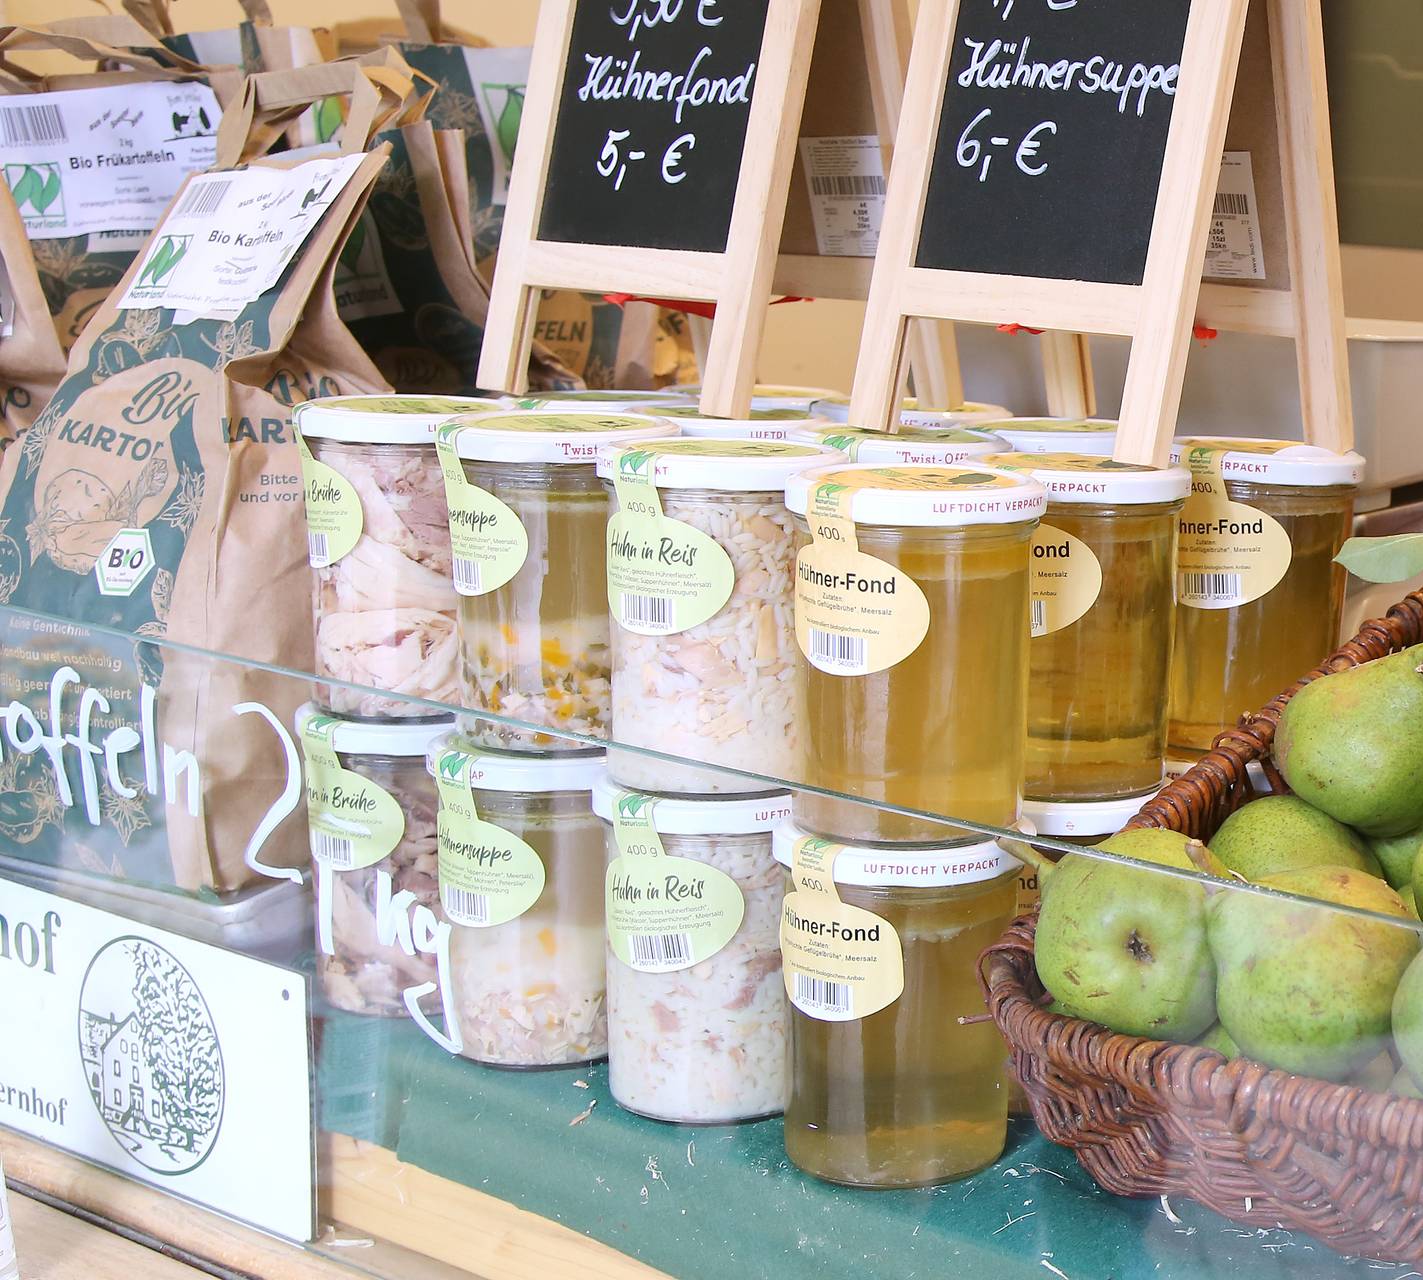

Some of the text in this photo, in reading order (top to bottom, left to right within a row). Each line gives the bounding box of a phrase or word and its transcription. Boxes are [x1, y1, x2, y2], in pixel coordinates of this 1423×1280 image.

[578, 46, 755, 124] Hühnerfond
[958, 36, 1181, 117] Hühnersuppe
[956, 108, 1009, 182] 6,-
[1015, 121, 1057, 176] €
[69, 157, 93, 170] Bio
[97, 150, 175, 168] Frükartoffeln
[597, 129, 696, 191] 5,- €
[207, 230, 230, 244] Bio
[260, 474, 298, 486] Bitte
[1191, 482, 1212, 494] 400
[240, 492, 269, 504] und
[311, 478, 342, 505] Brühe
[627, 500, 656, 517] 400 g
[932, 496, 1043, 513] LUFTDICHT VERPACKT
[817, 525, 840, 541] 400
[610, 528, 698, 567] Huhn in Reis
[1233, 546, 1261, 554] Meersalz
[798, 560, 896, 595] Hühner-Fond
[1038, 571, 1068, 579] Meersalz
[860, 606, 893, 617] Meersalz
[0, 666, 200, 827] offeln
[321, 788, 329, 804] in
[332, 786, 377, 812] Brühe
[449, 802, 472, 820] 400 g
[619, 819, 649, 828] Naturland
[627, 844, 658, 858] 400 g
[864, 857, 1001, 875] LUFTDICHT VERPACKT
[612, 873, 705, 904] Huhn in Reis
[801, 876, 823, 892] 400
[784, 904, 880, 942] Hühner-Fond
[845, 953, 878, 963] Meersalz
